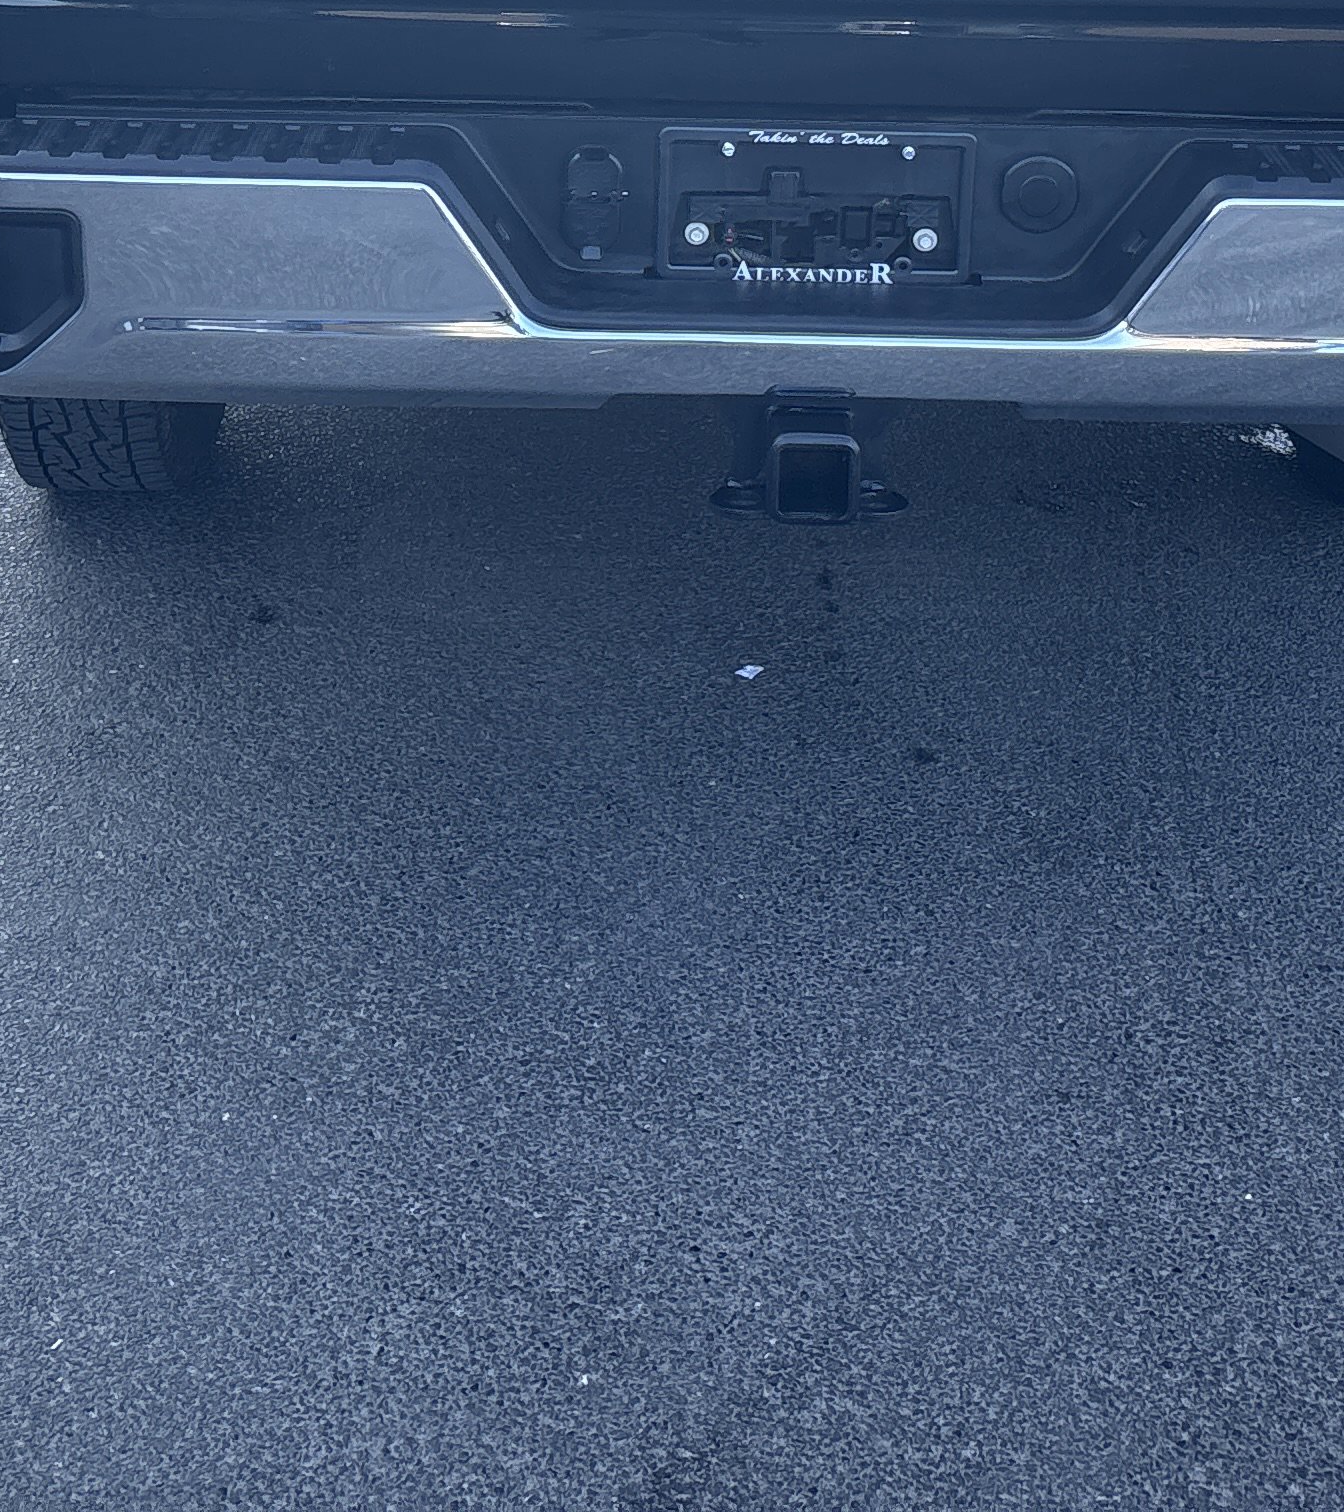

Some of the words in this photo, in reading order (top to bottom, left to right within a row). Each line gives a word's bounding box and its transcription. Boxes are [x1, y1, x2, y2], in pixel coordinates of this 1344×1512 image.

[749, 131, 805, 144] Takin'
[809, 132, 835, 144] the
[841, 133, 890, 146] Deals
